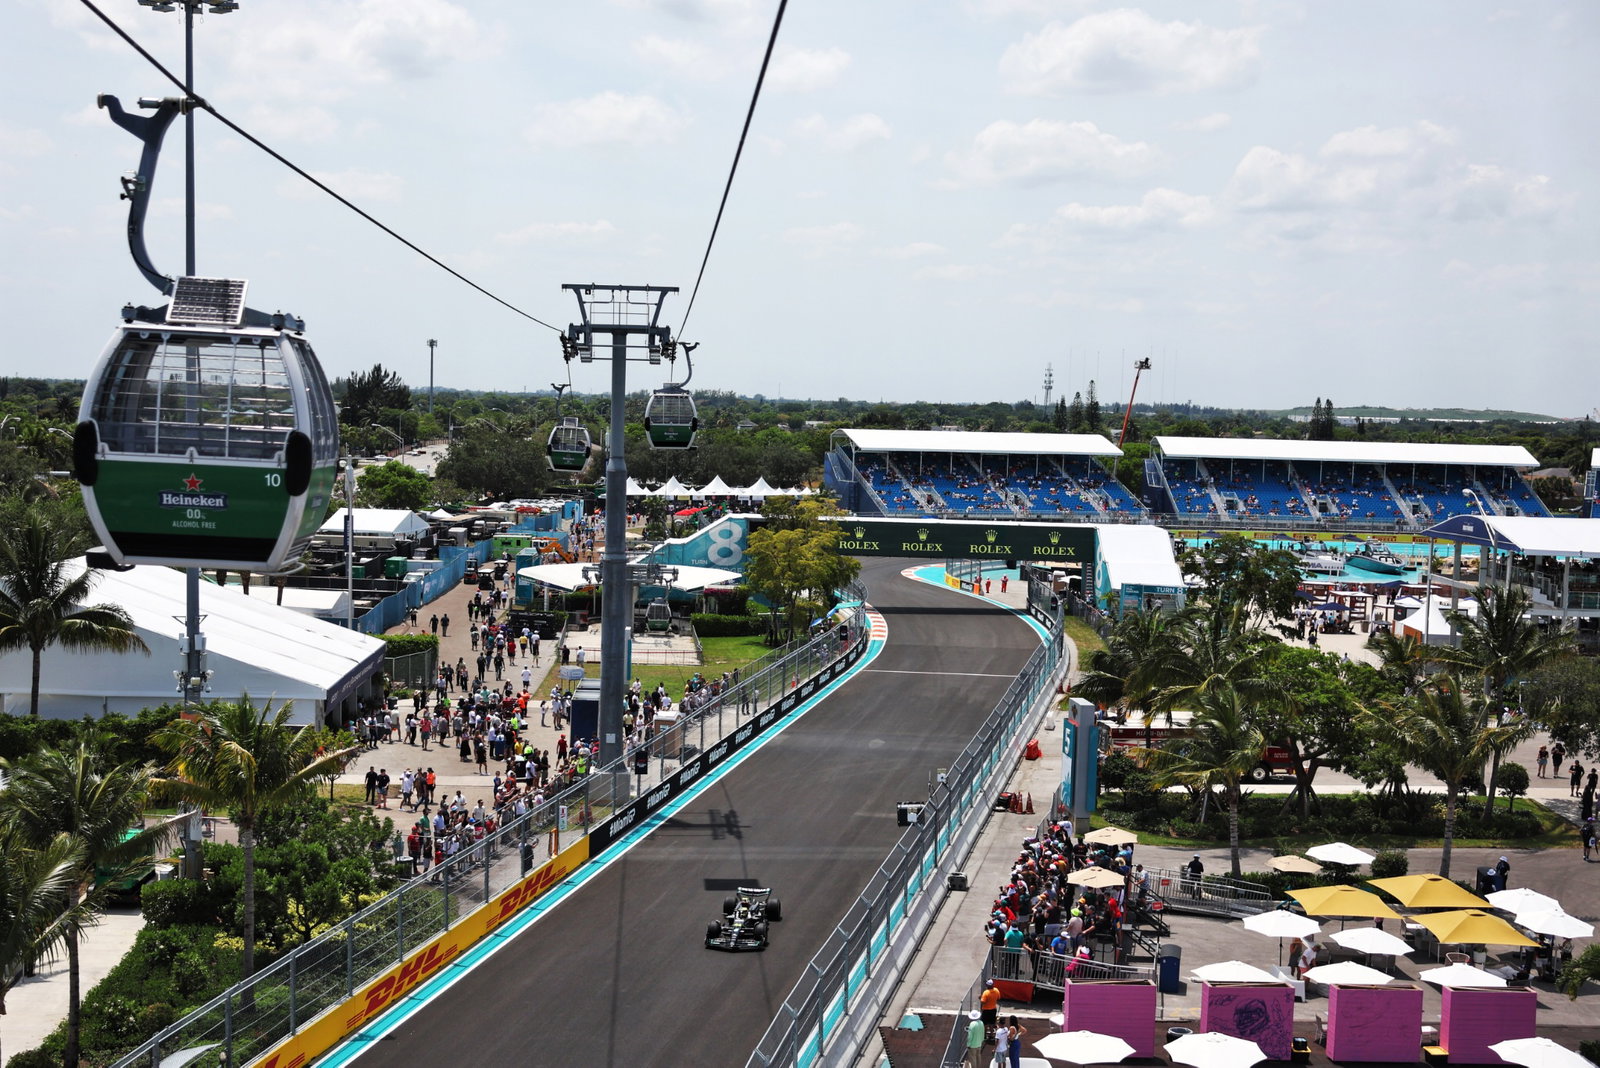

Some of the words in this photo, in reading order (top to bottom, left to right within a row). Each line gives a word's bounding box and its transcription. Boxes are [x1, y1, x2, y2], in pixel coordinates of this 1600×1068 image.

[265, 473, 281, 487] 10
[162, 493, 224, 507] Heineken
[172, 520, 200, 528] ALCOHOL
[201, 521, 216, 529] FREE
[707, 521, 743, 566] 8
[839, 540, 880, 550] ROLEX
[902, 542, 943, 552] ROLEX
[969, 544, 1012, 554] ROLEX
[1033, 546, 1076, 556] ROLEX
[1064, 727, 1071, 755] 5
[609, 808, 636, 837] #MiamiGP
[498, 864, 557, 921] DHL
[363, 942, 445, 1018] DHL
